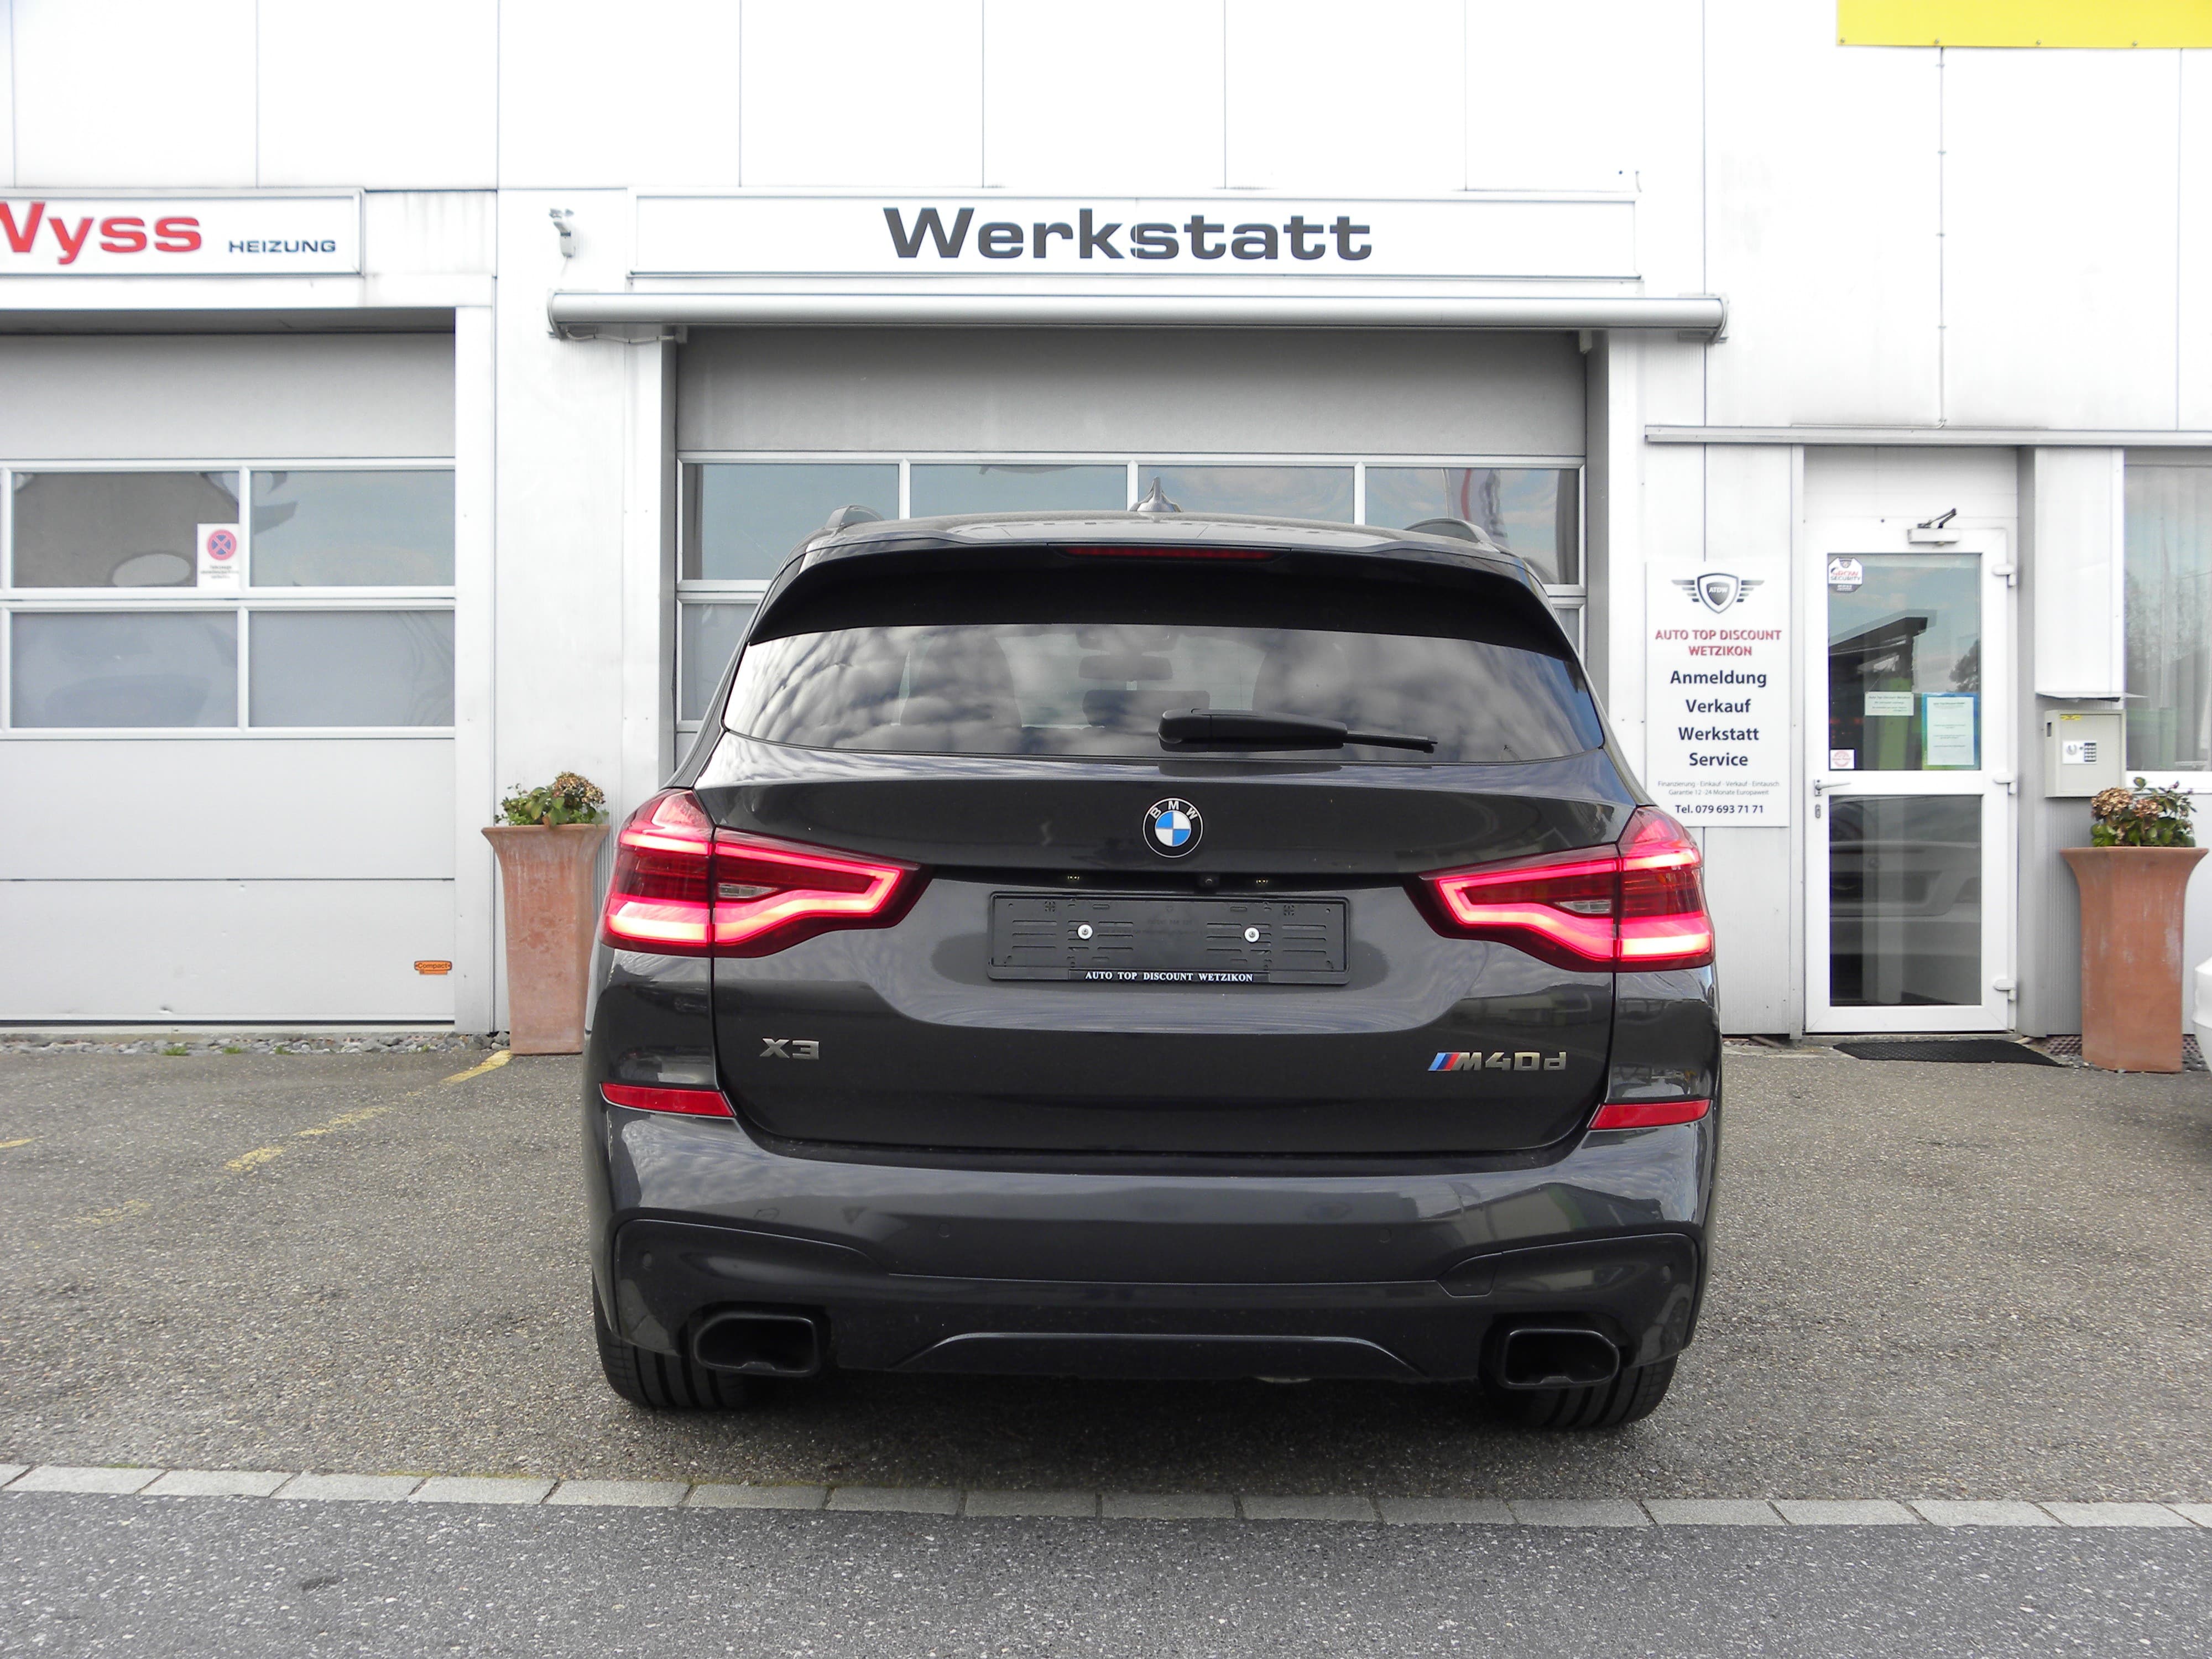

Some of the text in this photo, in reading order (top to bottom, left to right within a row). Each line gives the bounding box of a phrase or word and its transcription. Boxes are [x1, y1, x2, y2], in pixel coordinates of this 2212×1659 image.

[883, 207, 1372, 261] Werkstatt
[228, 239, 336, 253] HEIZUNG
[1656, 629, 1782, 640] AUTO TOP DISCOUNT
[1688, 645, 1752, 656] WETZIKON
[1670, 670, 1767, 688] Anmeldung
[1686, 698, 1751, 713] Verkauf
[1678, 726, 1759, 740] Werkstatt
[1689, 752, 1748, 766] Service
[1150, 800, 1198, 820] BMW
[1675, 805, 1764, 813] Tel. 079 693 71 71
[1085, 971, 1253, 982] AUTO TOP DISCOUNT WETZIKON
[759, 1038, 819, 1060] X3
[1451, 1051, 1567, 1071] M40d
